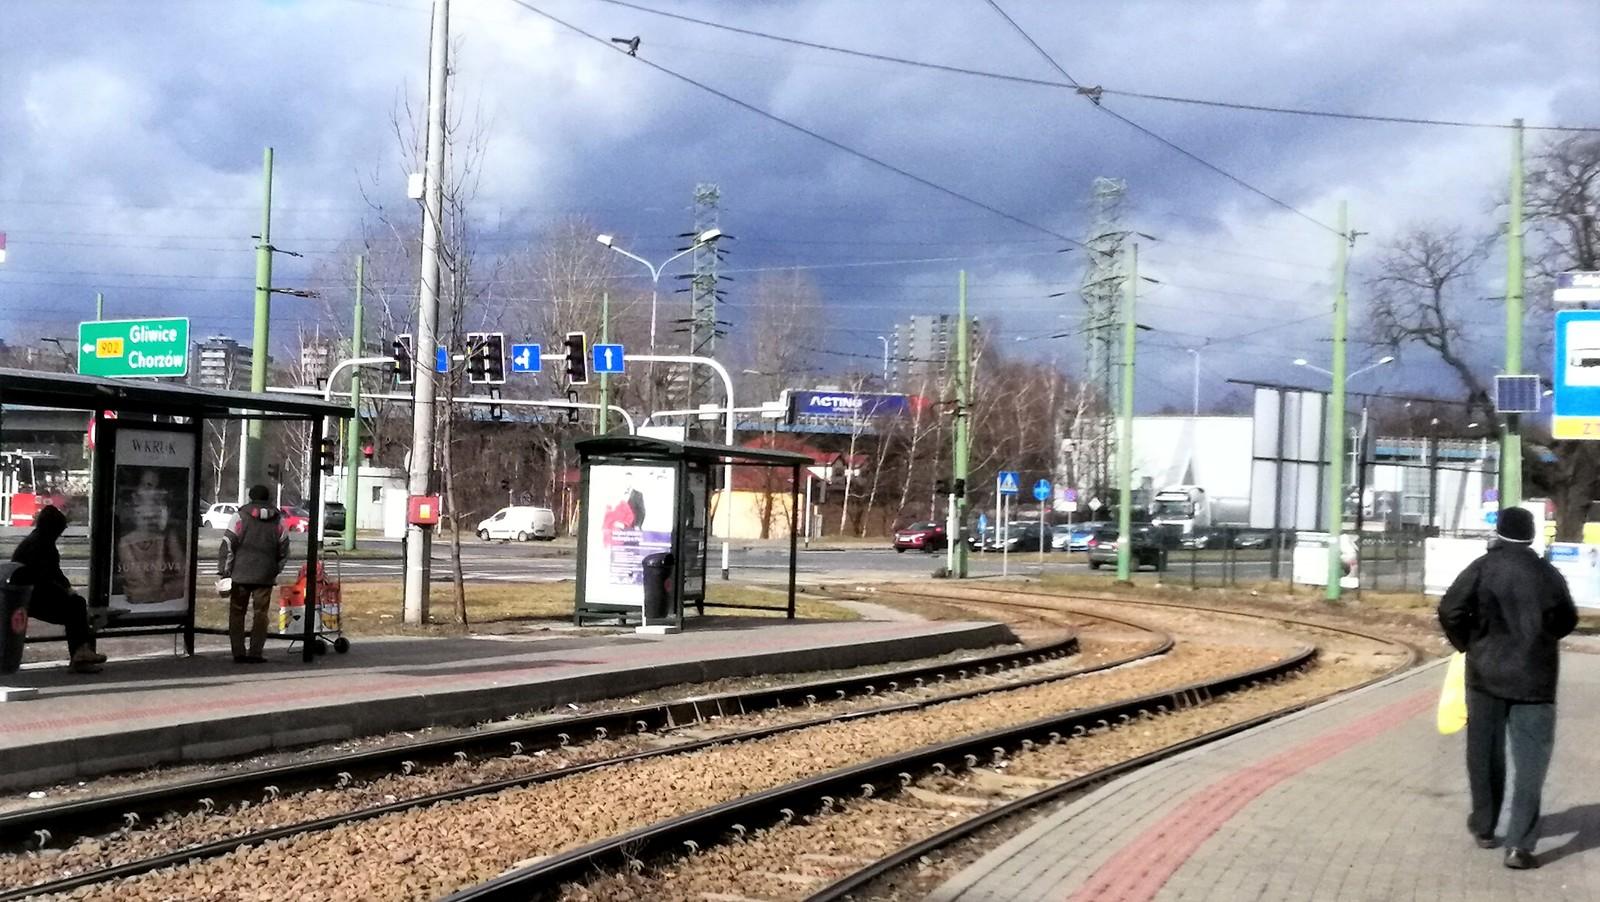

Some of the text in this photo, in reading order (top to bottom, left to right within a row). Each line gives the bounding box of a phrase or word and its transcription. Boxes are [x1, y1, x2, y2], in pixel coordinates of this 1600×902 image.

[129, 324, 177, 343] Gliwice
[101, 342, 118, 354] 902
[128, 350, 184, 369] Chorzów
[810, 396, 862, 408] ACTING
